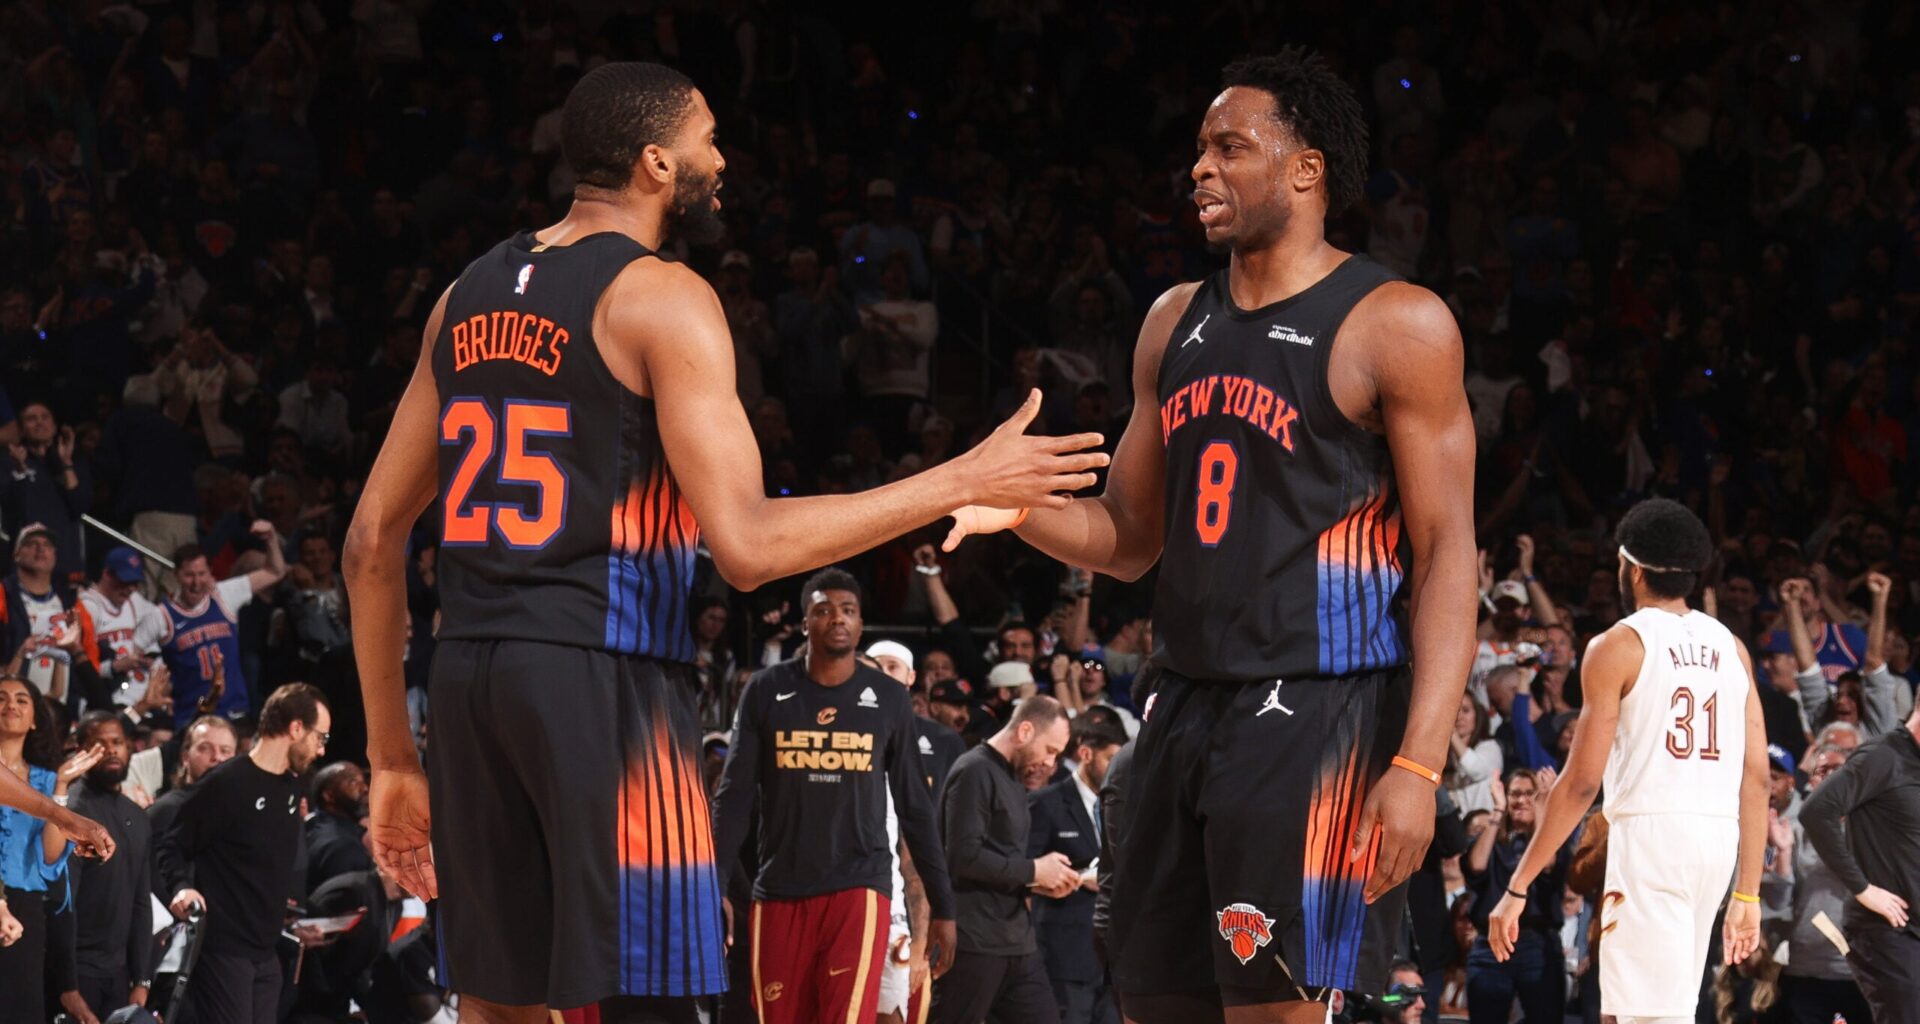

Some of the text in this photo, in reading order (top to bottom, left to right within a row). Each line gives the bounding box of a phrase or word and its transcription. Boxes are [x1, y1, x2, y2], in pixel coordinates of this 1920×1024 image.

[452, 311, 569, 376] BRIDGES
[1268, 330, 1314, 346] abu dhabi
[1160, 375, 1299, 456] NEW YORK
[440, 396, 572, 550] 25
[1196, 439, 1239, 548] 8
[1668, 643, 1720, 672] ALLEN
[776, 730, 873, 751] LET EM
[1666, 686, 1721, 760] 31
[776, 750, 873, 772] KNOW.
[1221, 909, 1269, 939] KNICKS
